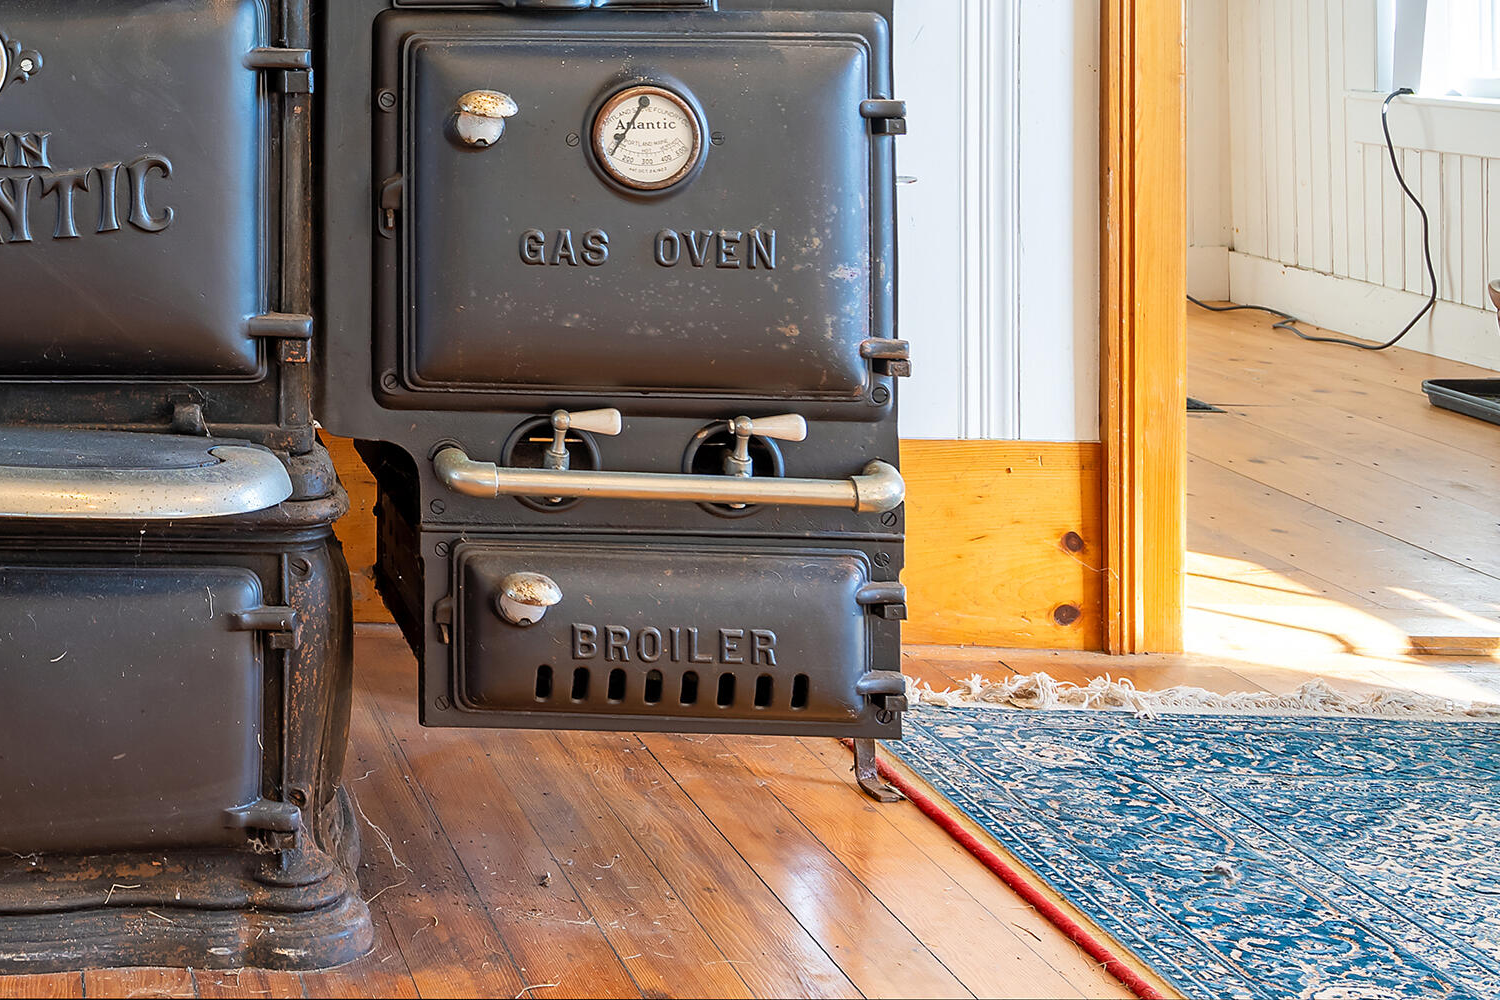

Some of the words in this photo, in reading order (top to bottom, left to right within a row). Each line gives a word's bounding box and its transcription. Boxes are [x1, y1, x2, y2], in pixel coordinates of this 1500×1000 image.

[621, 155, 634, 163] 200
[661, 154, 672, 162] 400
[519, 227, 610, 267] GAS
[654, 227, 776, 270] OVEN
[571, 622, 778, 667] BROILER
